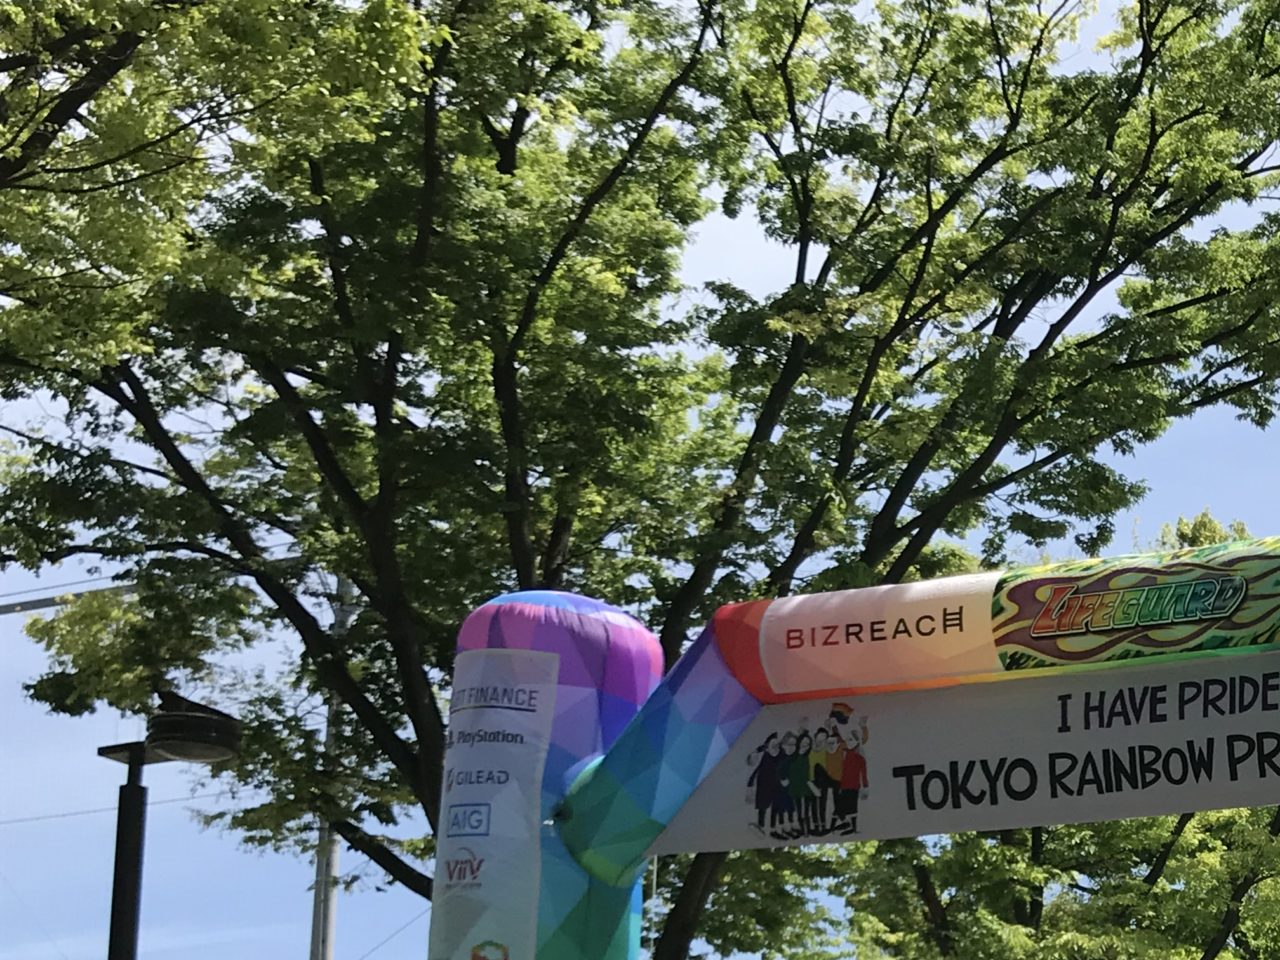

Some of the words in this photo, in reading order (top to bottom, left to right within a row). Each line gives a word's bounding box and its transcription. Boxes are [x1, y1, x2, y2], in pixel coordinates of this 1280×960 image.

[786, 605, 964, 650] BIZREACH
[468, 686, 539, 708] FINANCE
[1057, 693, 1072, 734] I
[1084, 685, 1168, 731] HAVE
[1178, 672, 1280, 721] PRIDE
[457, 729, 524, 748] PlayStation
[456, 770, 510, 786] GILEAD
[892, 757, 1038, 811] TOKYO
[1048, 736, 1215, 799] RAINBOW
[451, 809, 484, 831] AIG
